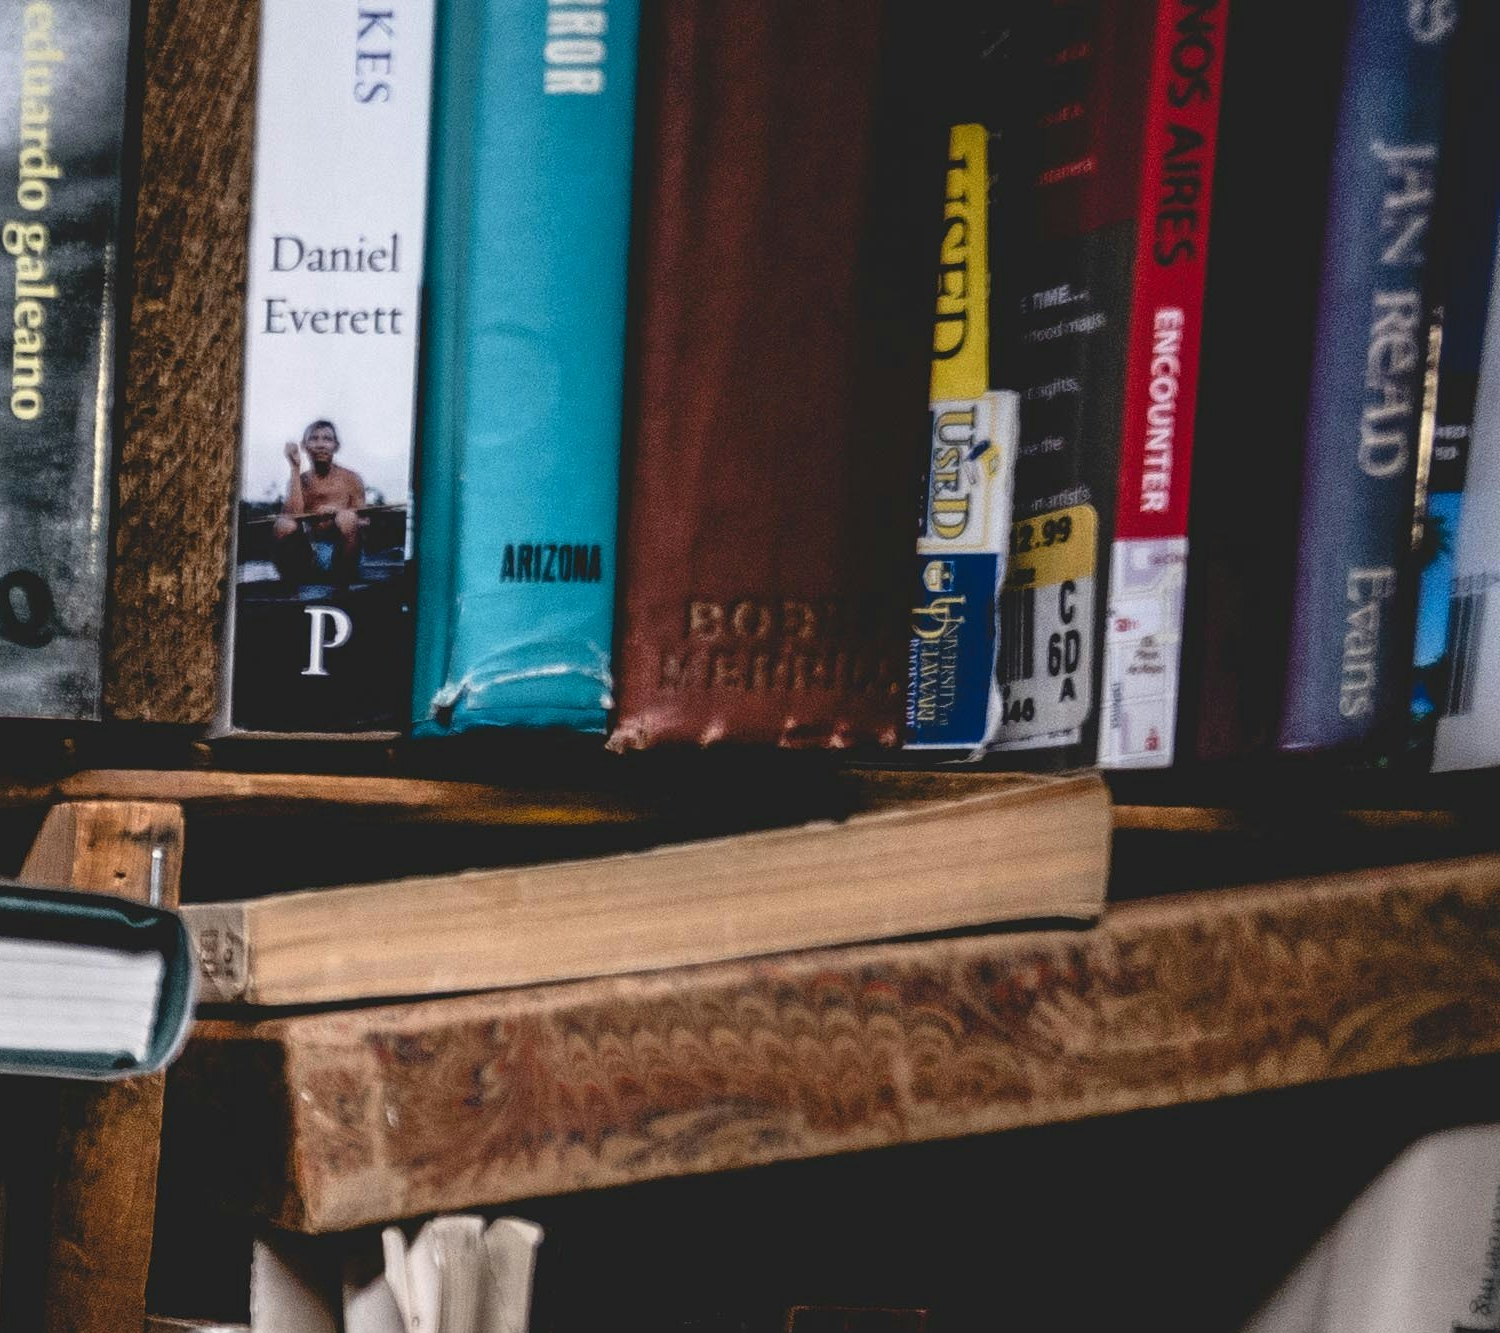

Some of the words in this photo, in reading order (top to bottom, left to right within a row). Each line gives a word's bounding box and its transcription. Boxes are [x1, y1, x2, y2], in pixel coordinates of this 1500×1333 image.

[271, 234, 401, 273] Daniel
[261, 297, 402, 336] Everett
[1139, 308, 1184, 513] ENCOUNTER
[502, 543, 601, 582] ARIZONA
